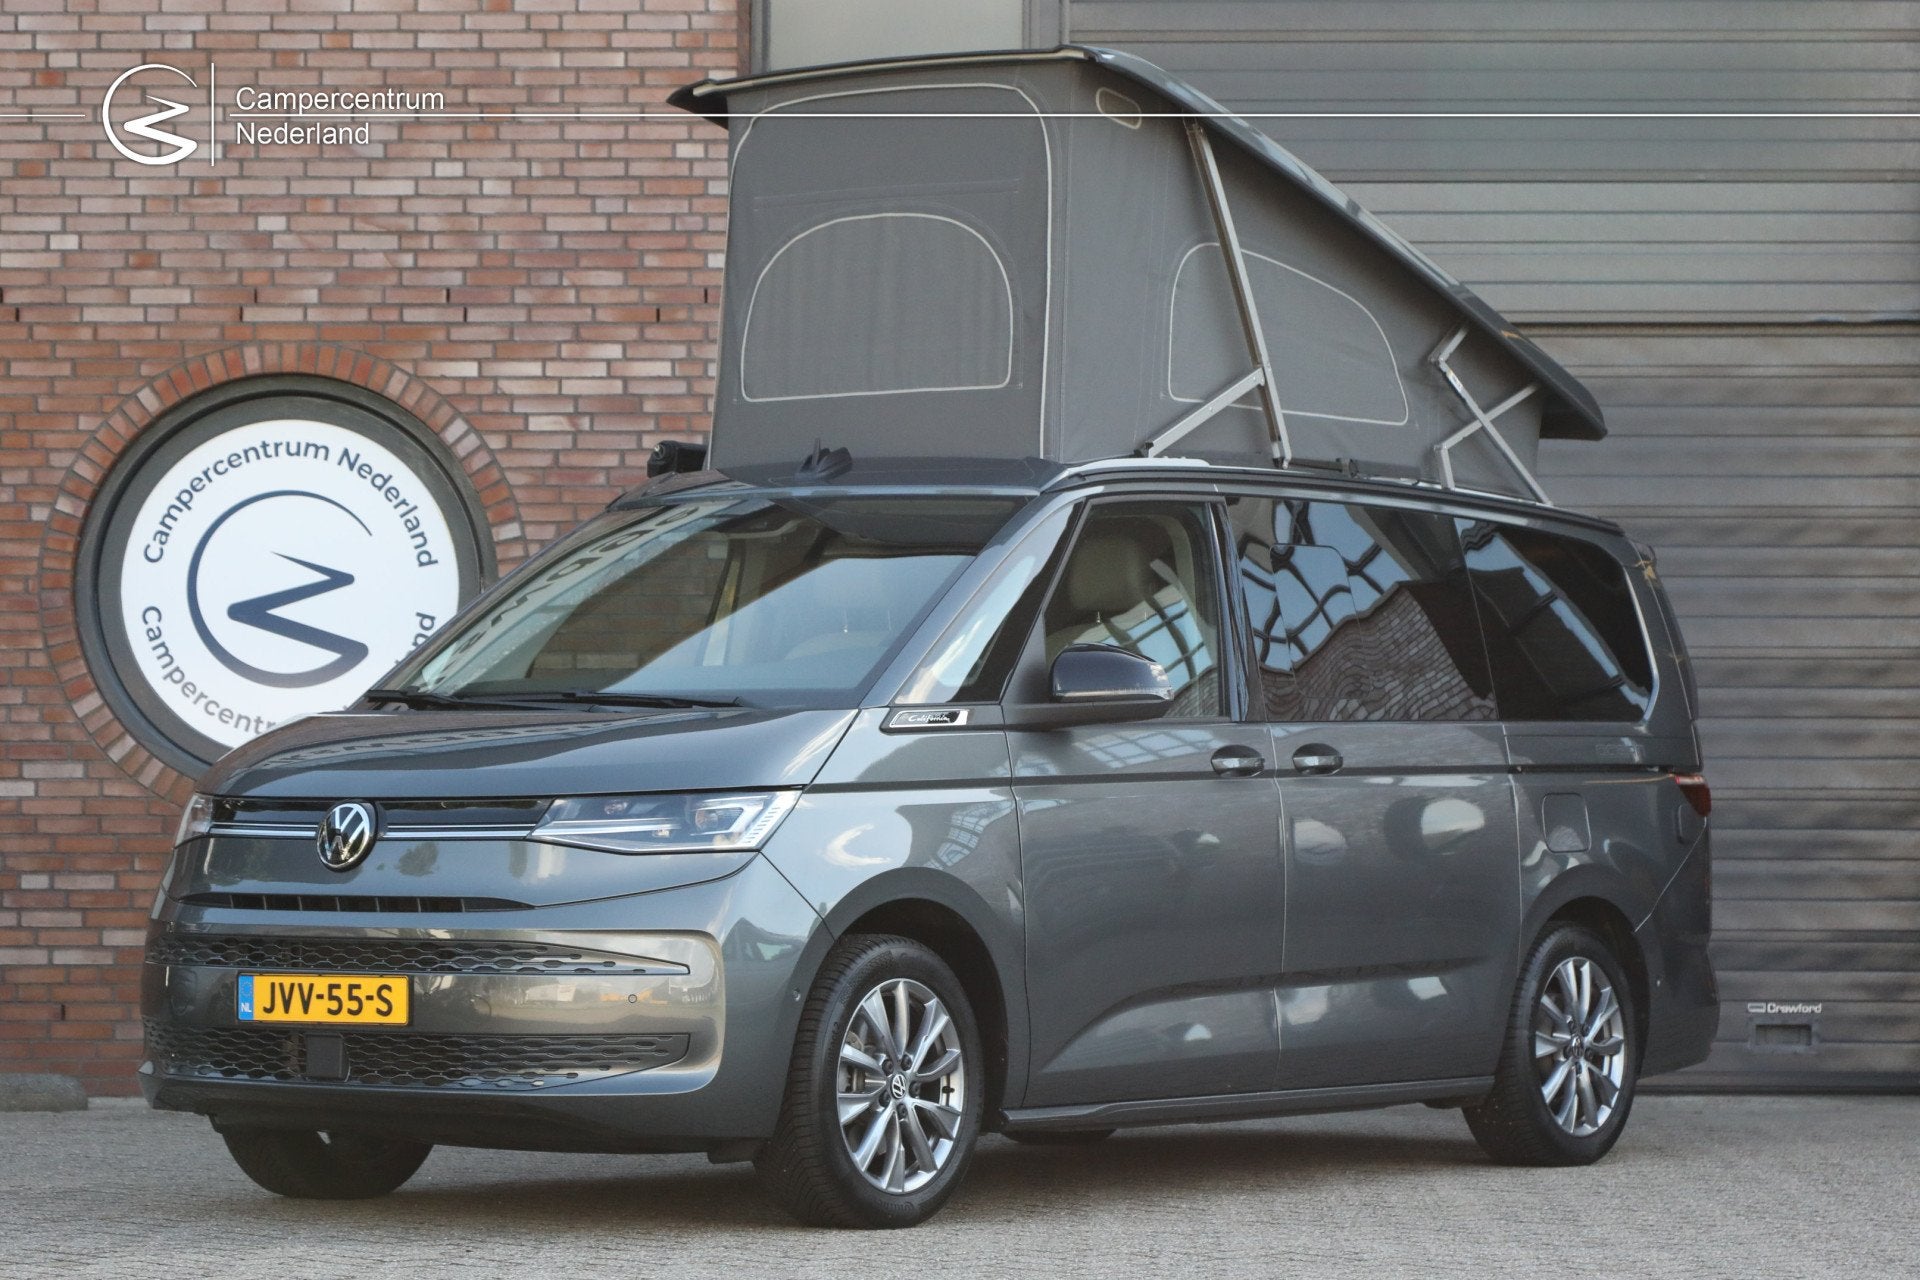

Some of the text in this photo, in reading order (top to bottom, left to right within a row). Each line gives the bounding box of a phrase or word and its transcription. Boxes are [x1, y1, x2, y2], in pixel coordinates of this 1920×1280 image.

[143, 439, 439, 568] Campercentrum Nederland
[240, 1002, 252, 1013] NL
[262, 982, 394, 1017] JVV-55-S
[1767, 1002, 1822, 1014] Crawford
